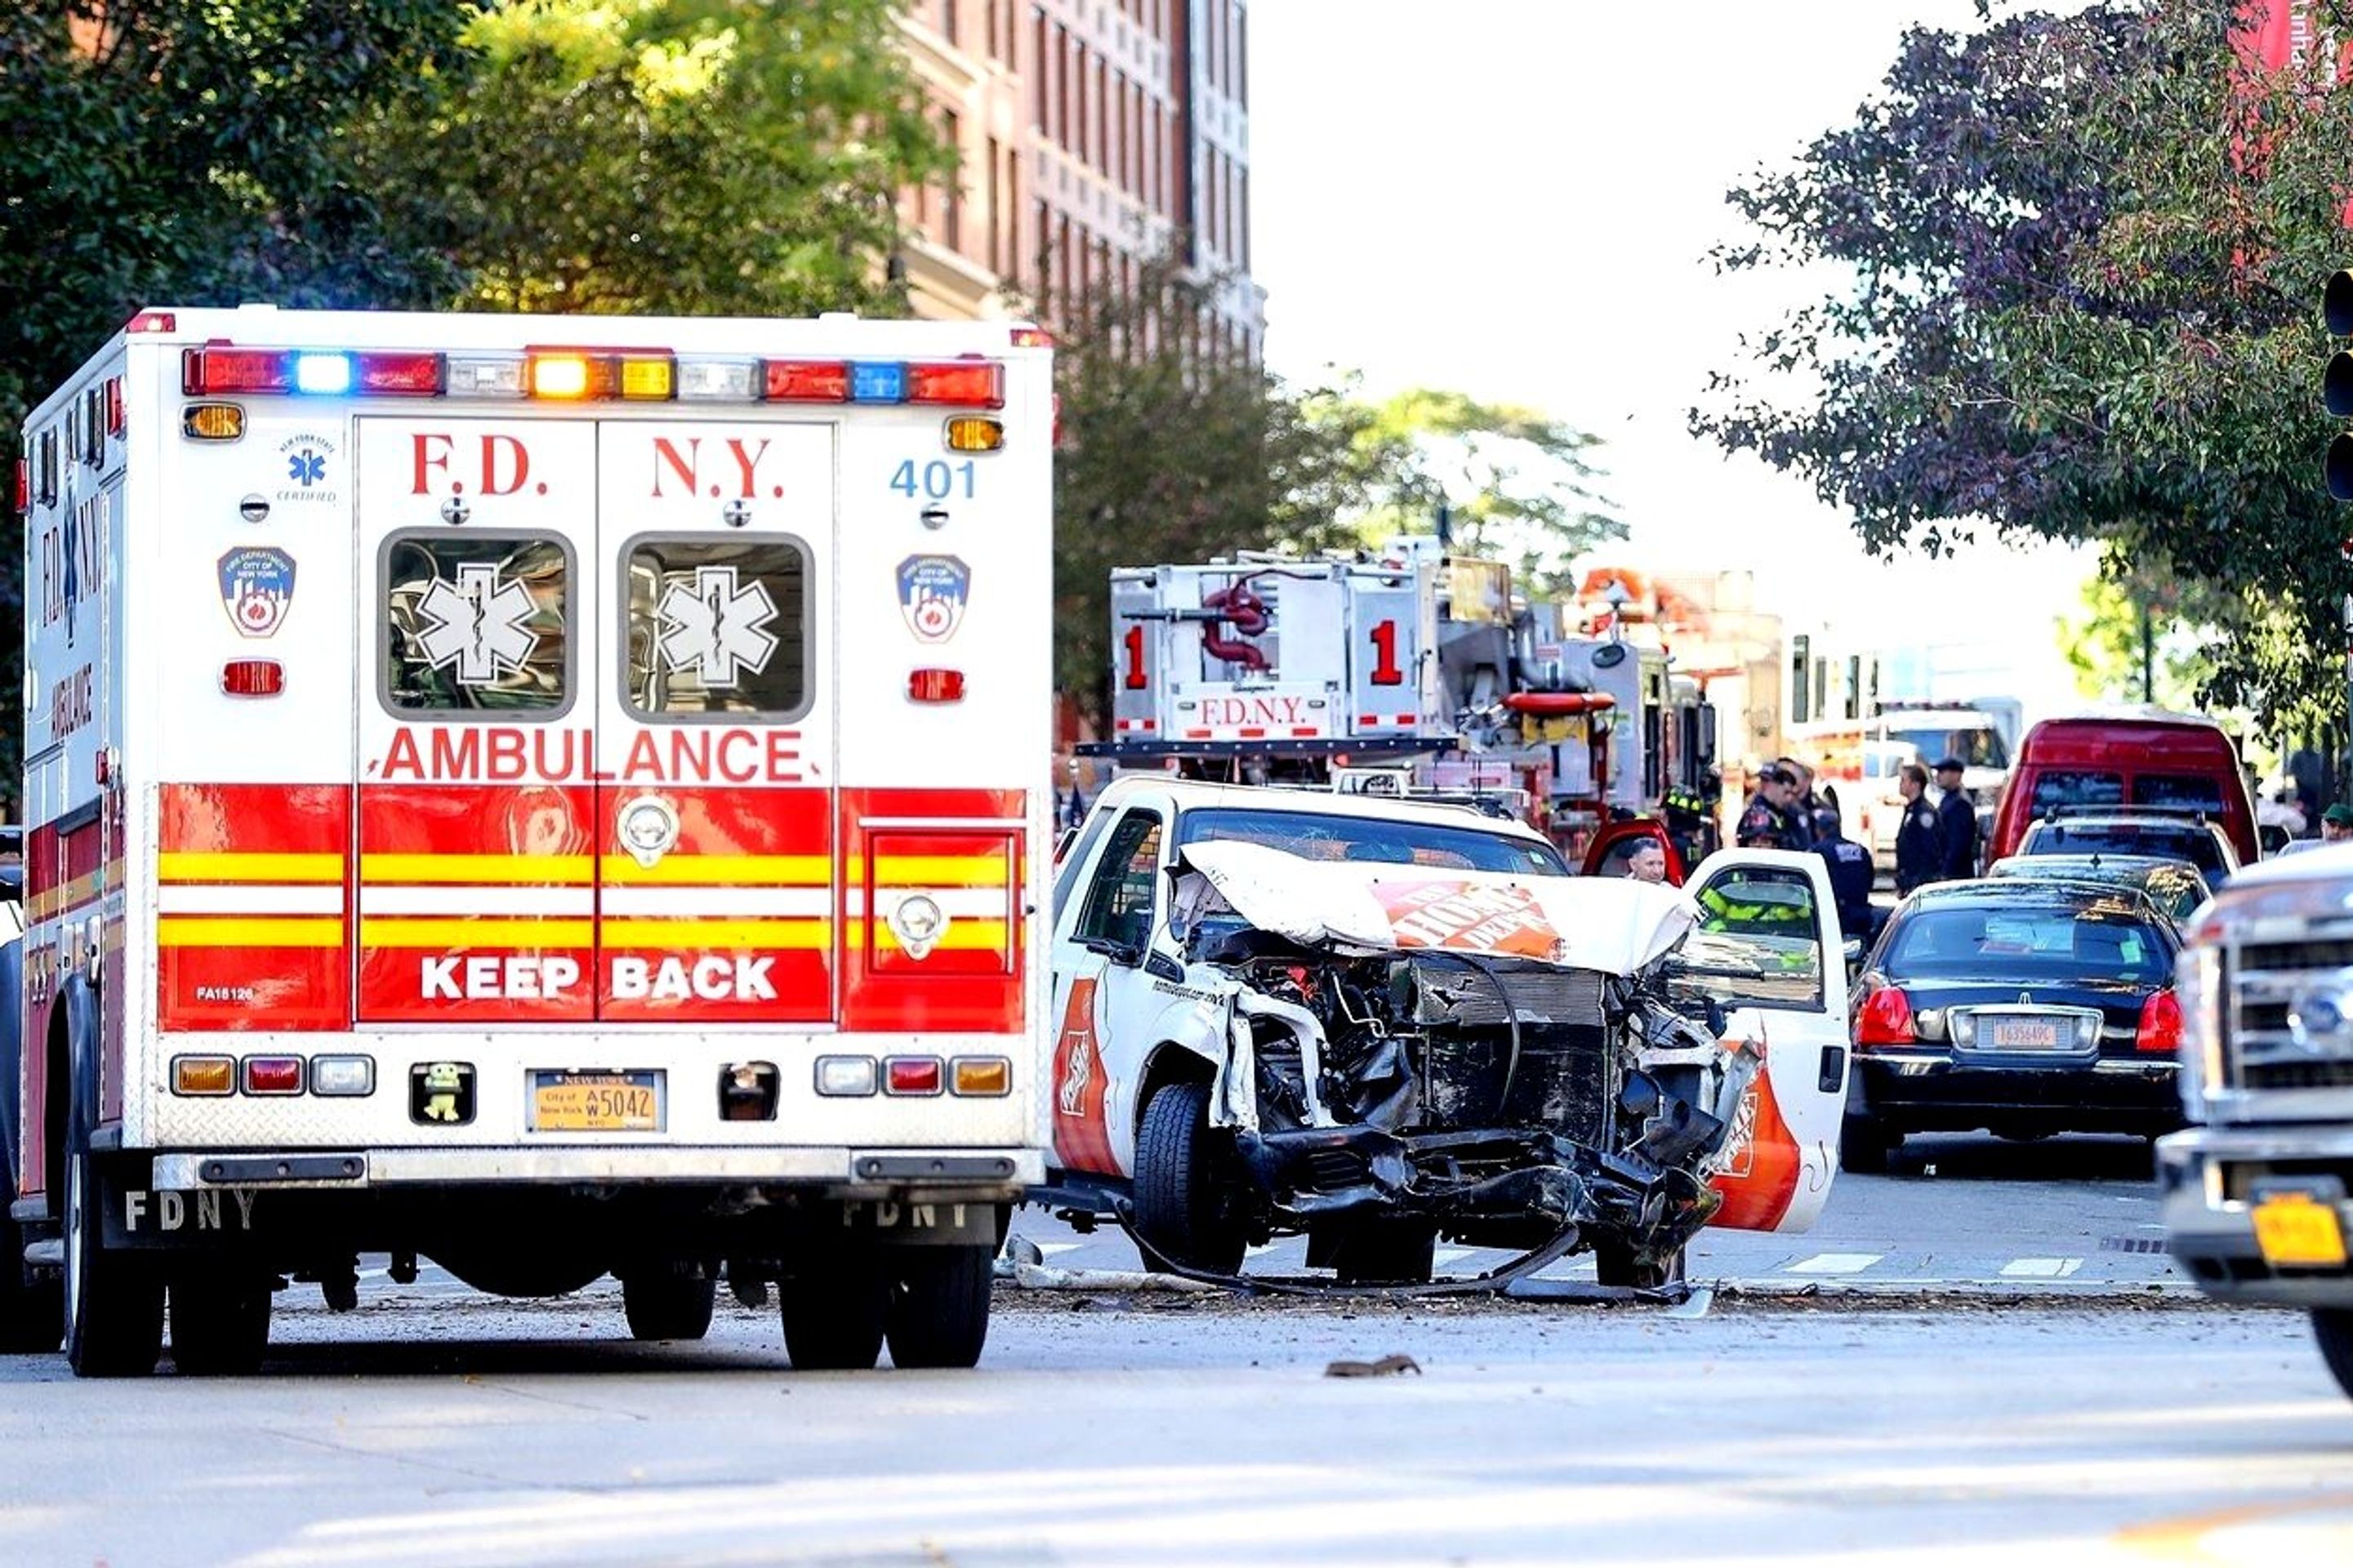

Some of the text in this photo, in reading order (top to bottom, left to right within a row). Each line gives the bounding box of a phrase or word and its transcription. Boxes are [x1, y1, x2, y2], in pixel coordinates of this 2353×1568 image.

[411, 433, 784, 499] F.D. N.Y.
[889, 459, 975, 499] 401
[237, 570, 279, 578] NEW YORK
[1124, 625, 1147, 689] 1
[1370, 620, 1403, 686] 1
[1201, 697, 1307, 725] F.D.N.Y.
[381, 728, 803, 782] AMBULANCE
[421, 956, 779, 1000] KEEP BACK
[546, 1092, 564, 1102] City
[599, 1089, 651, 1117] 5042
